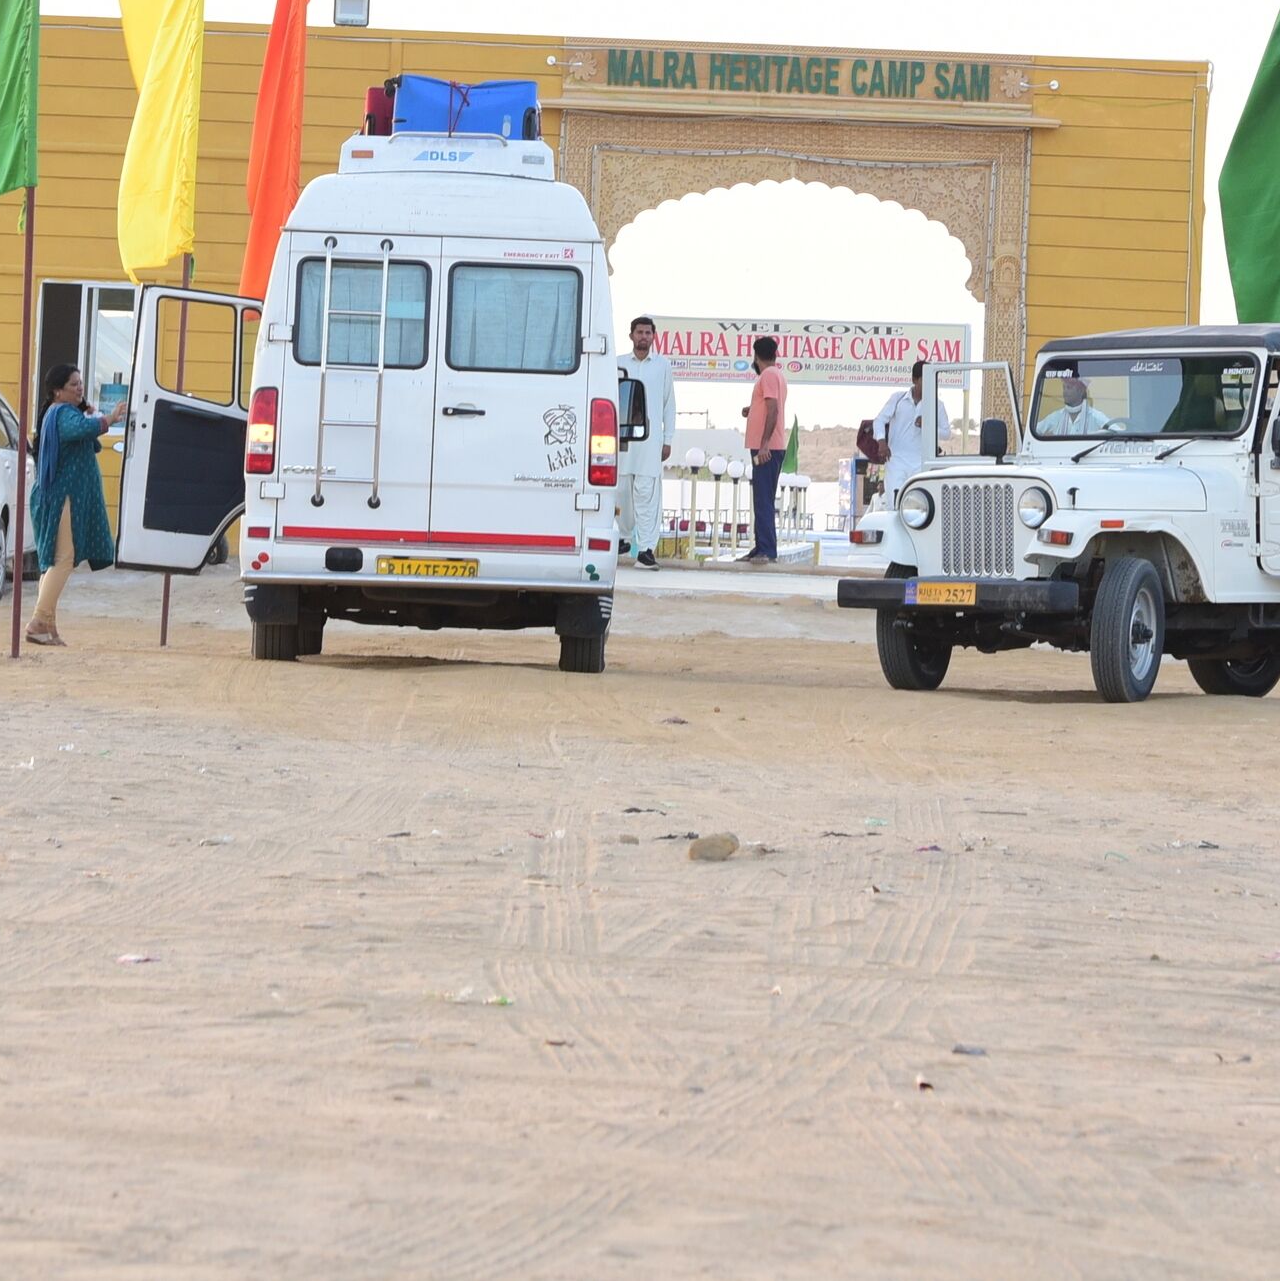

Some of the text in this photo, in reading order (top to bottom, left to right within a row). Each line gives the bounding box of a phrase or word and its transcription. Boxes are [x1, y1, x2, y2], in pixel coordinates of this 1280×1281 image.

[608, 48, 990, 102] MALRA HERITAGE CAMP SAM
[429, 151, 457, 162] DLS
[718, 322, 905, 336] WEL COME
[651, 331, 730, 357] MALRA
[850, 336, 910, 362] CAMP
[916, 338, 961, 363] SAM
[944, 589, 973, 603] 2527
